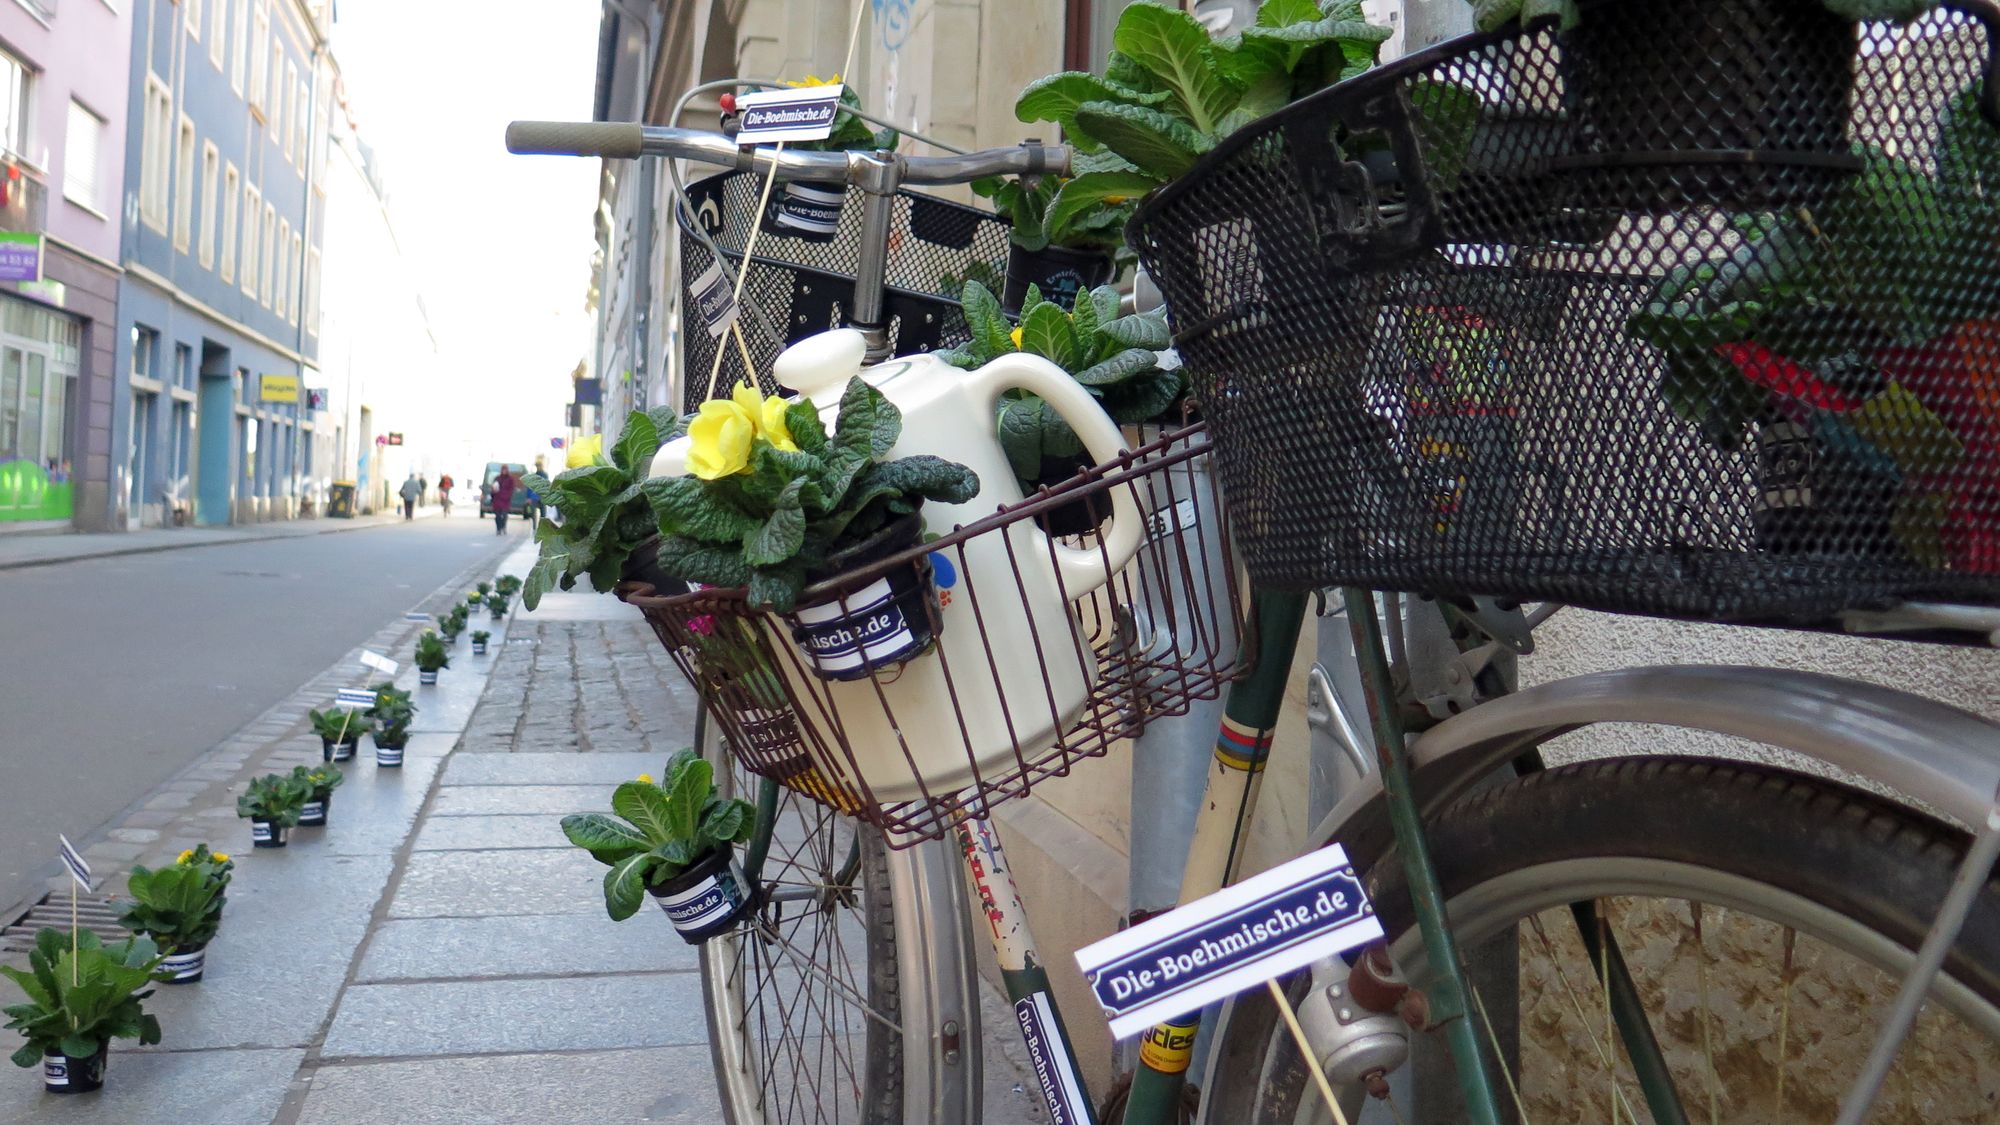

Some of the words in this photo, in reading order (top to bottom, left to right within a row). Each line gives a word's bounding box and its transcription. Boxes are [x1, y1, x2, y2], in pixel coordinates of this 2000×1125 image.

[747, 106, 831, 125] Die-Boehmische.de
[669, 895, 719, 919] mische.de
[1109, 891, 1348, 1000] Die-Boehmische.de
